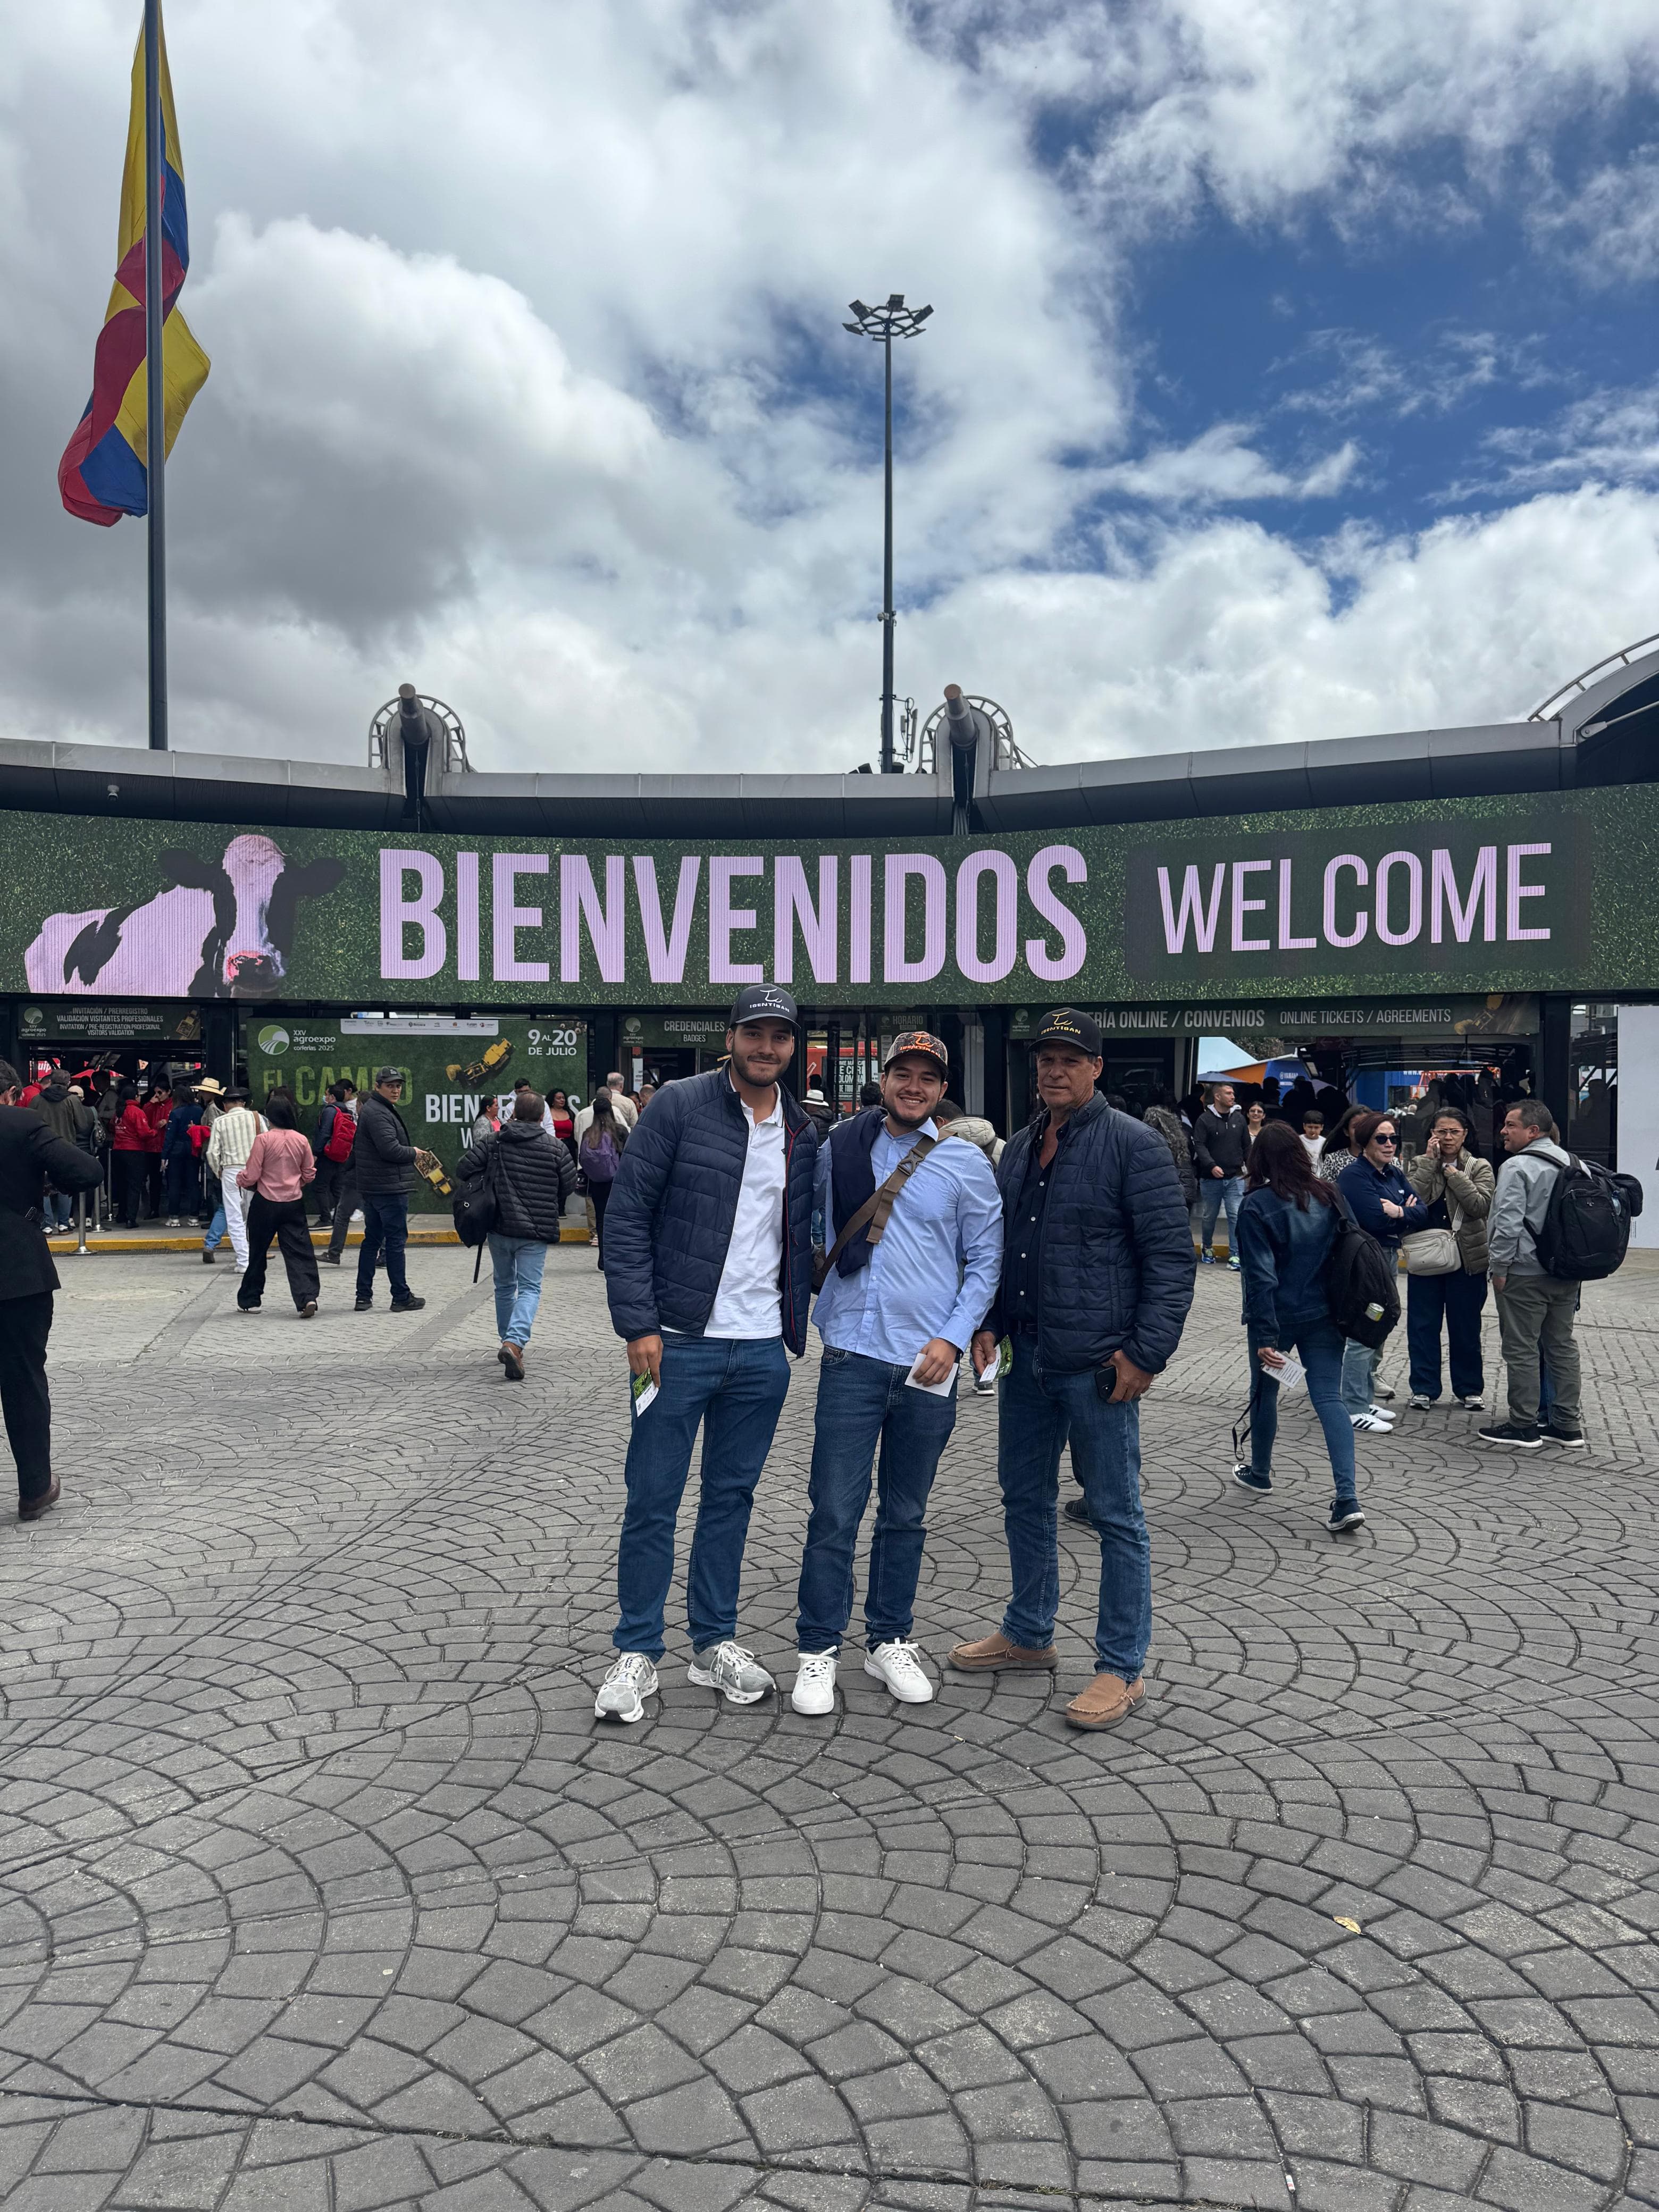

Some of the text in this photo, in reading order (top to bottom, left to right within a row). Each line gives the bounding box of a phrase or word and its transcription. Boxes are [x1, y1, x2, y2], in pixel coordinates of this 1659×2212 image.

[1157, 842, 1552, 954] WELCOME
[380, 844, 1088, 984] BIENVENIDOS
[893, 1015, 924, 1025] HORARIO
[1119, 1011, 1168, 1028] ONLINE
[1171, 1011, 1180, 1028] /
[1184, 1009, 1265, 1028] CONVENIOS
[1280, 1009, 1451, 1024] ONLINE TICKETS / AGREEMENTS
[664, 1020, 725, 1032] CREDENCIALES
[293, 1036, 336, 1044] agroexpo
[528, 1029, 541, 1045] 9
[552, 1029, 577, 1046] 20
[683, 1034, 706, 1043] BADGES
[528, 1047, 577, 1055] DE JULIO
